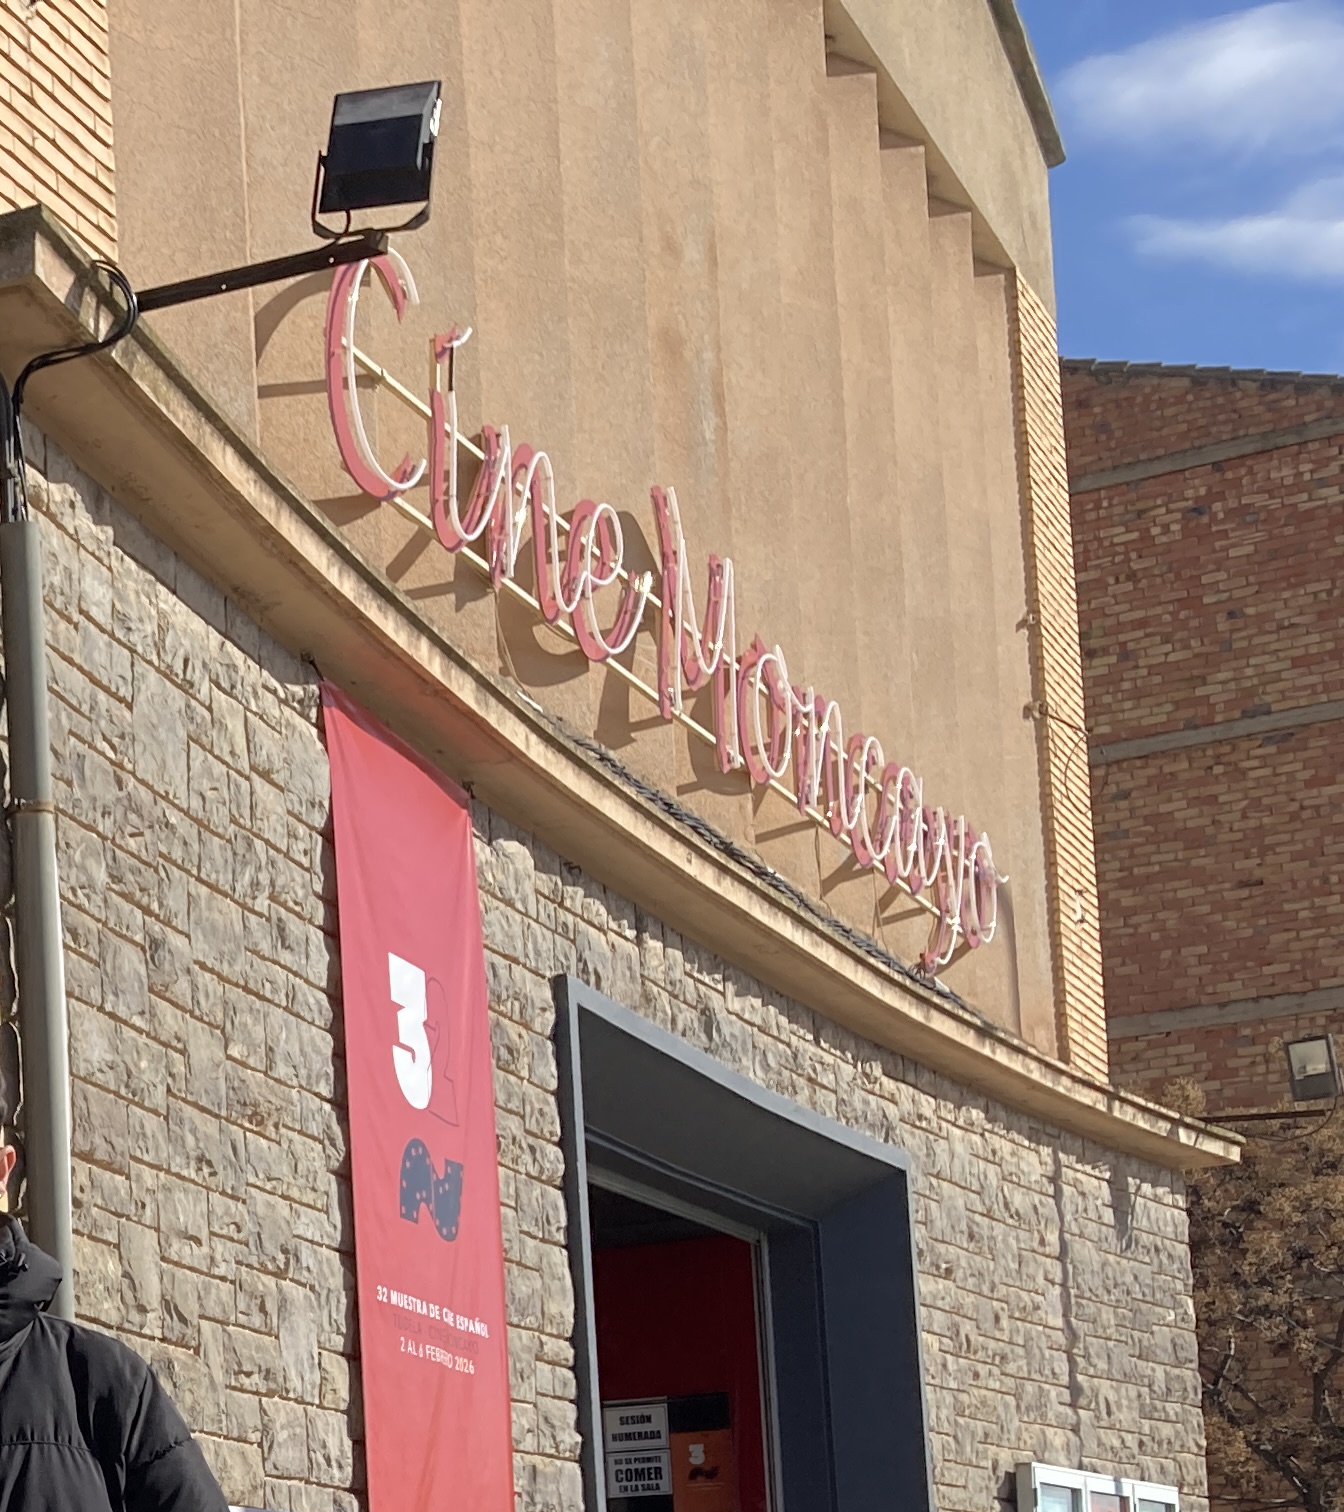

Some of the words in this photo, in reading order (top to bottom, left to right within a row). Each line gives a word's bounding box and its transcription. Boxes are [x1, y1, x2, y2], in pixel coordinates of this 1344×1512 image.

[325, 246, 652, 662] Cine
[376, 1284, 388, 1303] 32
[390, 1289, 428, 1316] MUESTRA
[429, 1303, 441, 1320] DE
[456, 1314, 490, 1339] ESPAÑOL
[400, 1336, 406, 1352] 2
[407, 1339, 418, 1356] AL
[454, 1355, 475, 1375] 2026
[619, 1413, 652, 1426] SESIÓN
[611, 1430, 662, 1443] NUMERADA
[633, 1455, 662, 1465] PERMITE
[614, 1466, 663, 1483] COMER
[629, 1484, 640, 1492] LA
[640, 1482, 661, 1492] SALA
